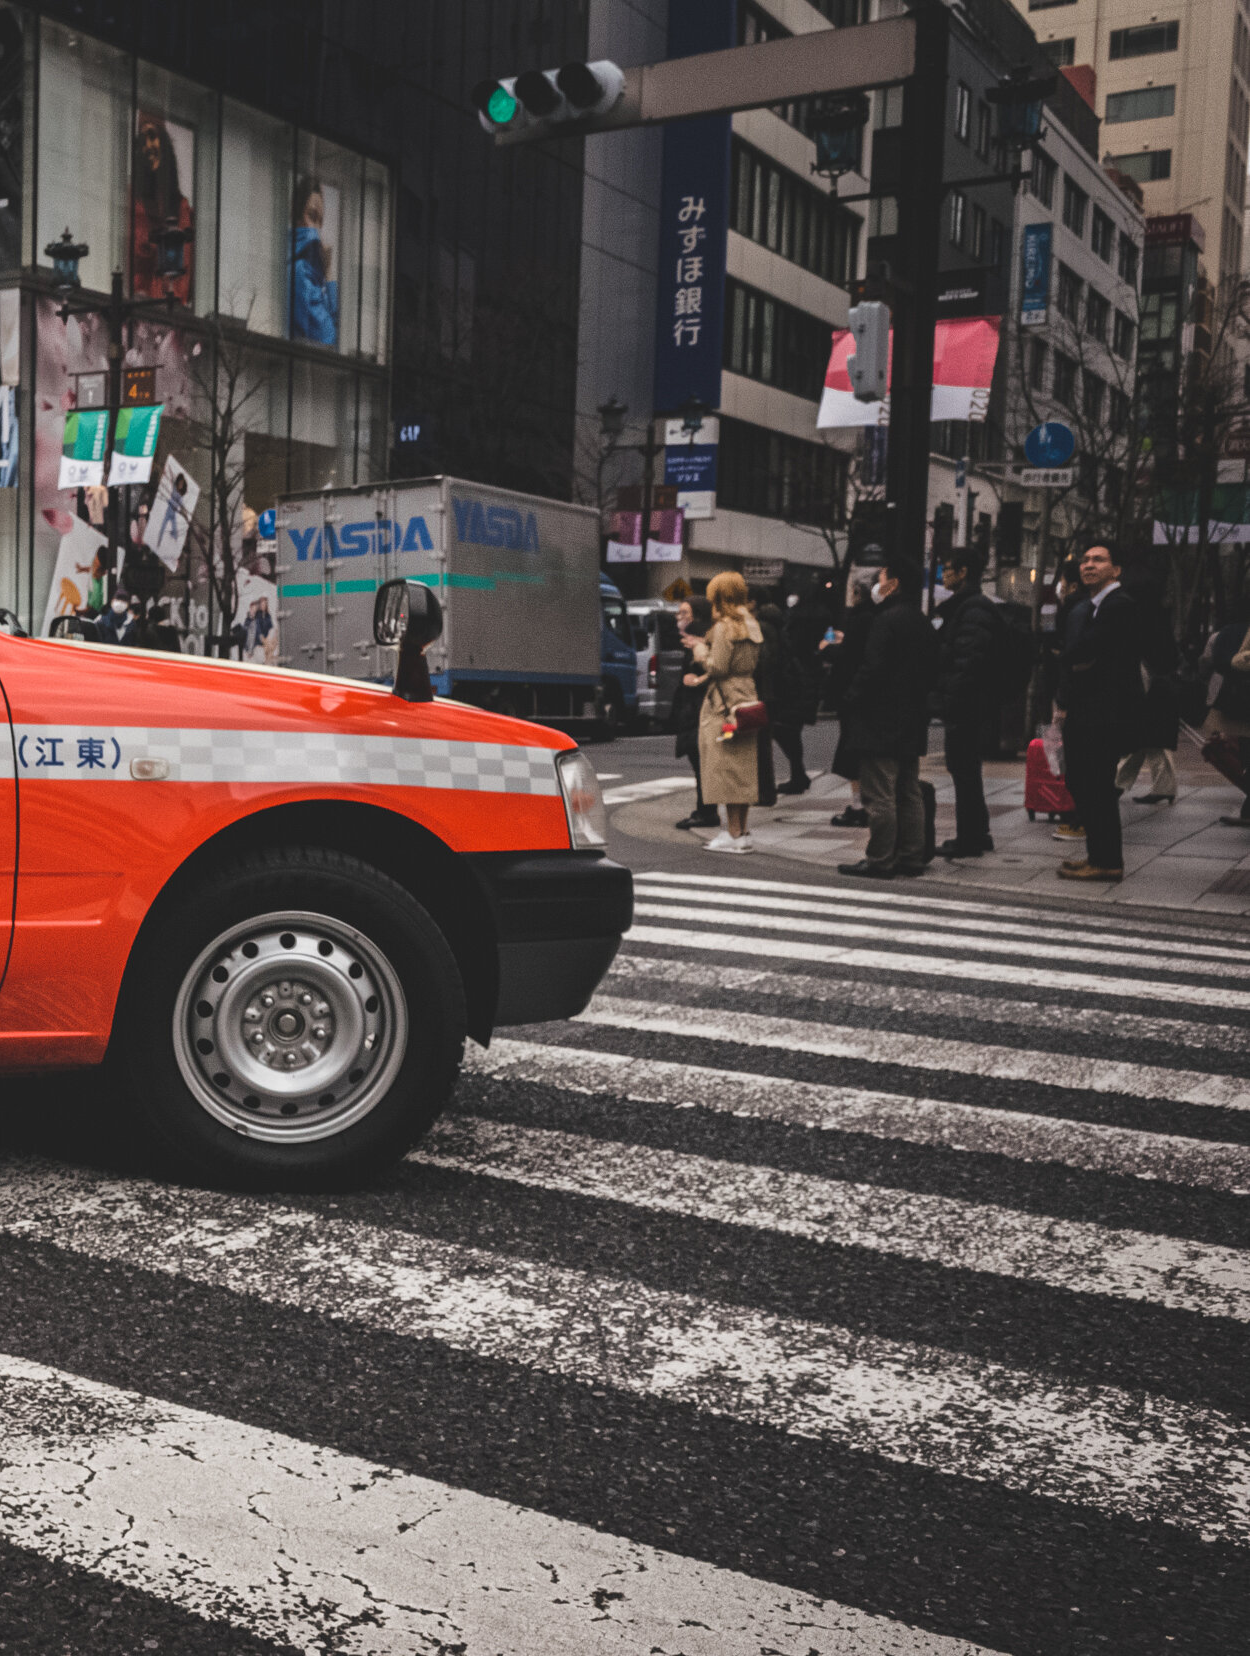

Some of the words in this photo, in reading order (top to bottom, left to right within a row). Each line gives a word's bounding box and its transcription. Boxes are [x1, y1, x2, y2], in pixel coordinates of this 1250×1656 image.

[673, 195, 706, 347] みずほ銀行
[287, 515, 435, 561] YASDA
[452, 498, 540, 552] YASDA
[18, 734, 121, 770] (江東)
